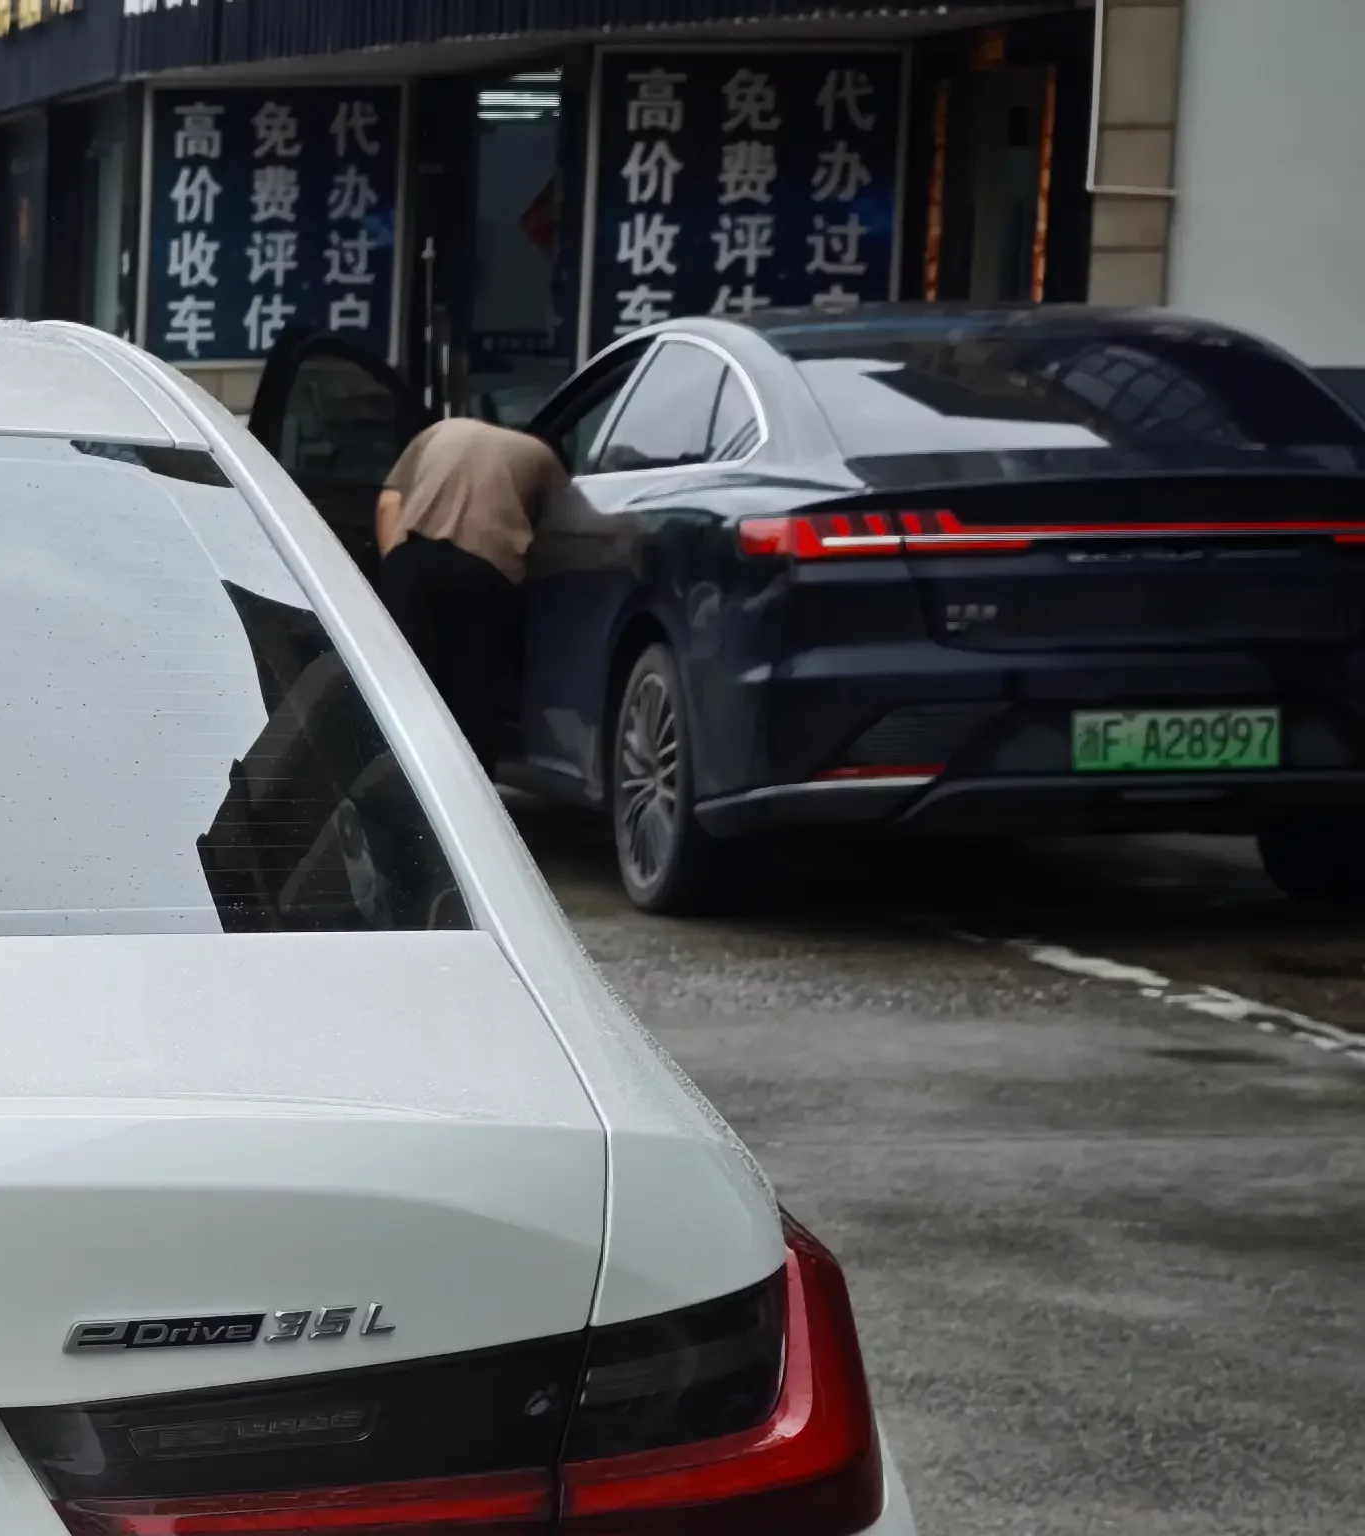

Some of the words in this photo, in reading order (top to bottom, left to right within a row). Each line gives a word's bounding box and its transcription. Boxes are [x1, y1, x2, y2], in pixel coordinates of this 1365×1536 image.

[165, 101, 225, 359] 高价收车
[242, 100, 304, 351] 免费评估
[613, 67, 687, 337] 高价收车
